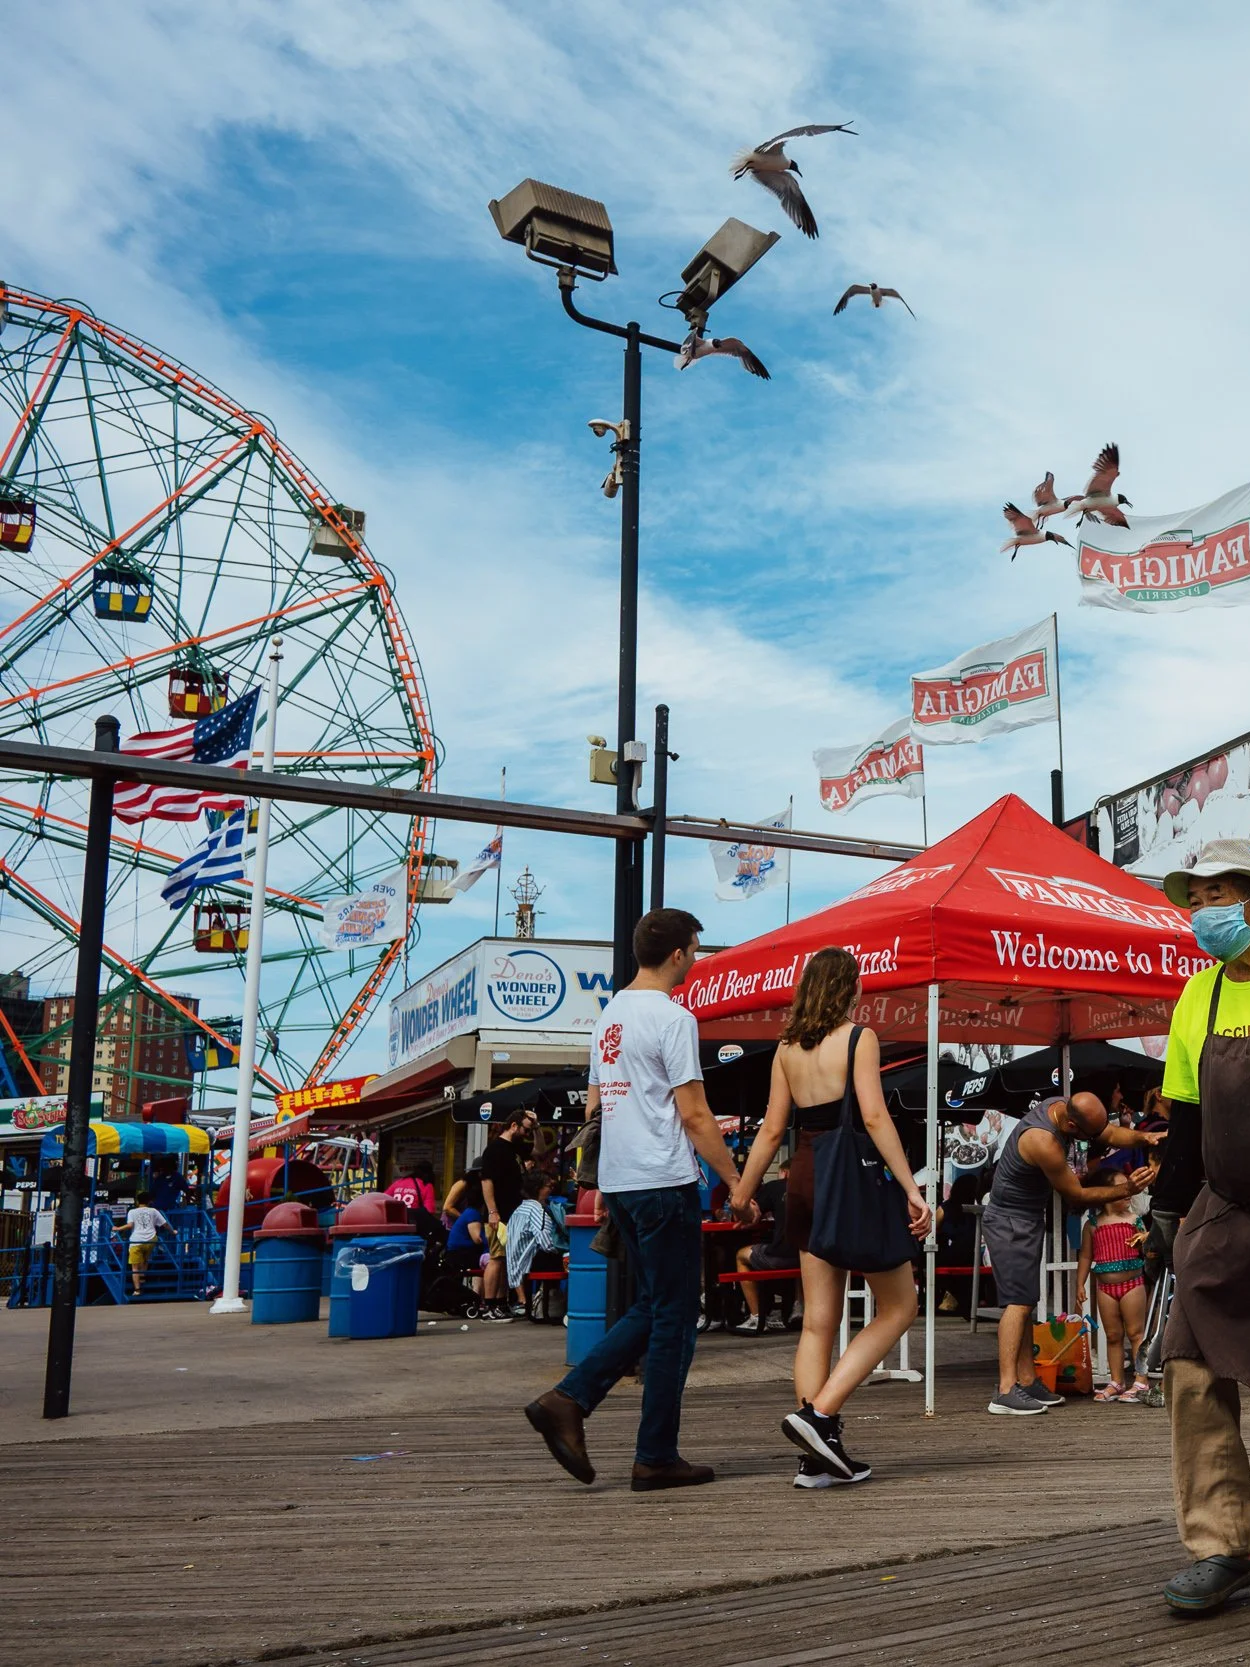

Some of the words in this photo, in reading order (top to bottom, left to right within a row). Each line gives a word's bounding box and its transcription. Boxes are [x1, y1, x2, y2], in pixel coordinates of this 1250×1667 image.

[1006, 878, 1192, 932] FAMIGLIA
[990, 930, 1120, 972] Welcome
[1125, 945, 1152, 975] to
[490, 957, 553, 980] Deno's
[496, 981, 558, 995] WONDER
[687, 973, 723, 1010] Cold
[721, 969, 761, 1001] Beer
[761, 954, 799, 991] and
[402, 1000, 439, 1055] WONDER
[441, 966, 478, 1025] WHEEL
[502, 994, 550, 1006] WHEEL
[962, 1076, 987, 1097] PEPSI
[15, 1181, 37, 1189] PEPSI
